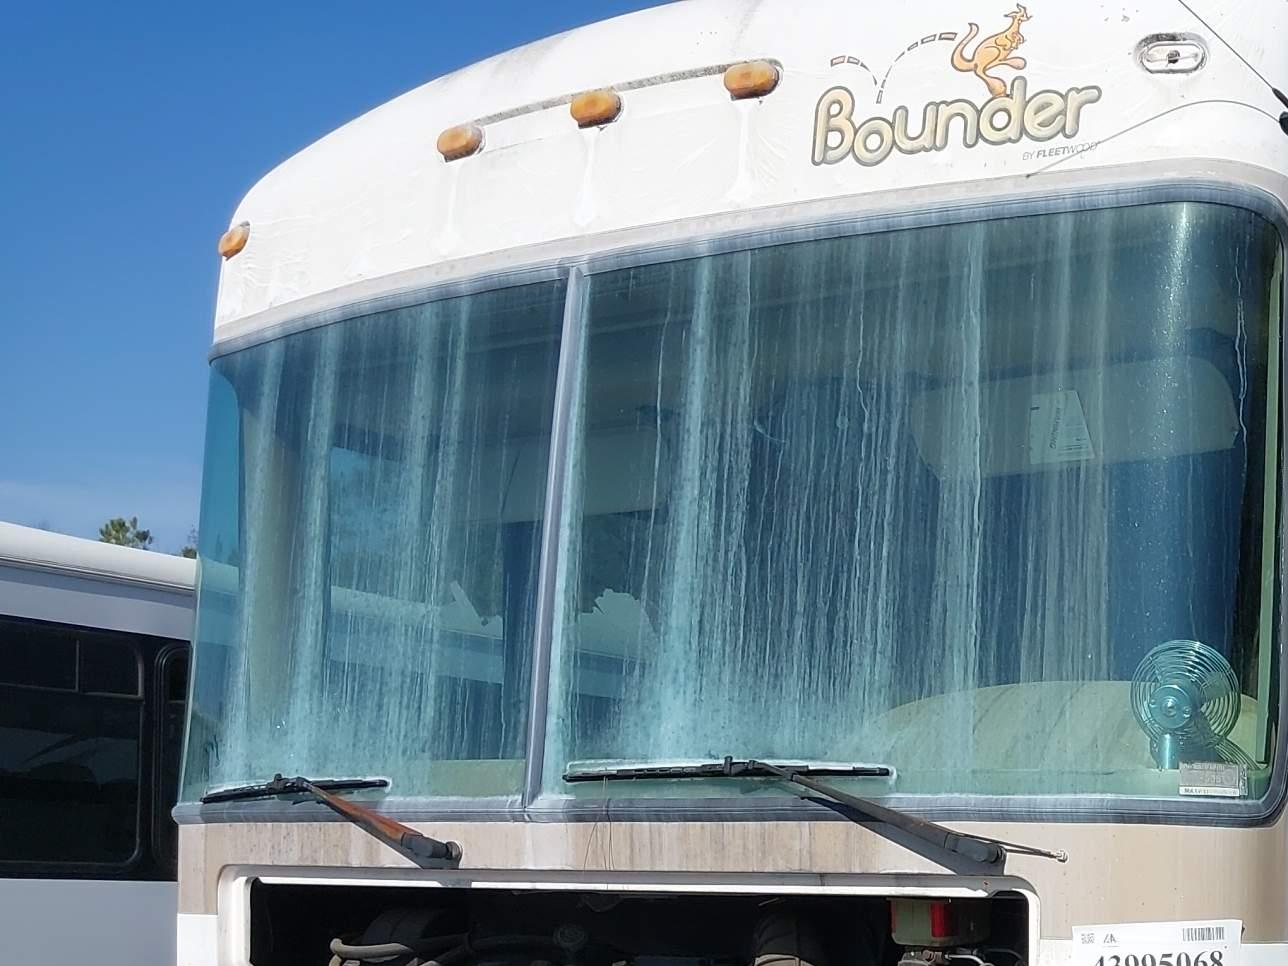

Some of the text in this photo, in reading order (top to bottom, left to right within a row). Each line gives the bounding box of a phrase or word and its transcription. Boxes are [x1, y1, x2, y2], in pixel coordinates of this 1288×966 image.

[811, 76, 1102, 167] Bounder
[1022, 141, 1097, 160] BY FLEETWOOD
